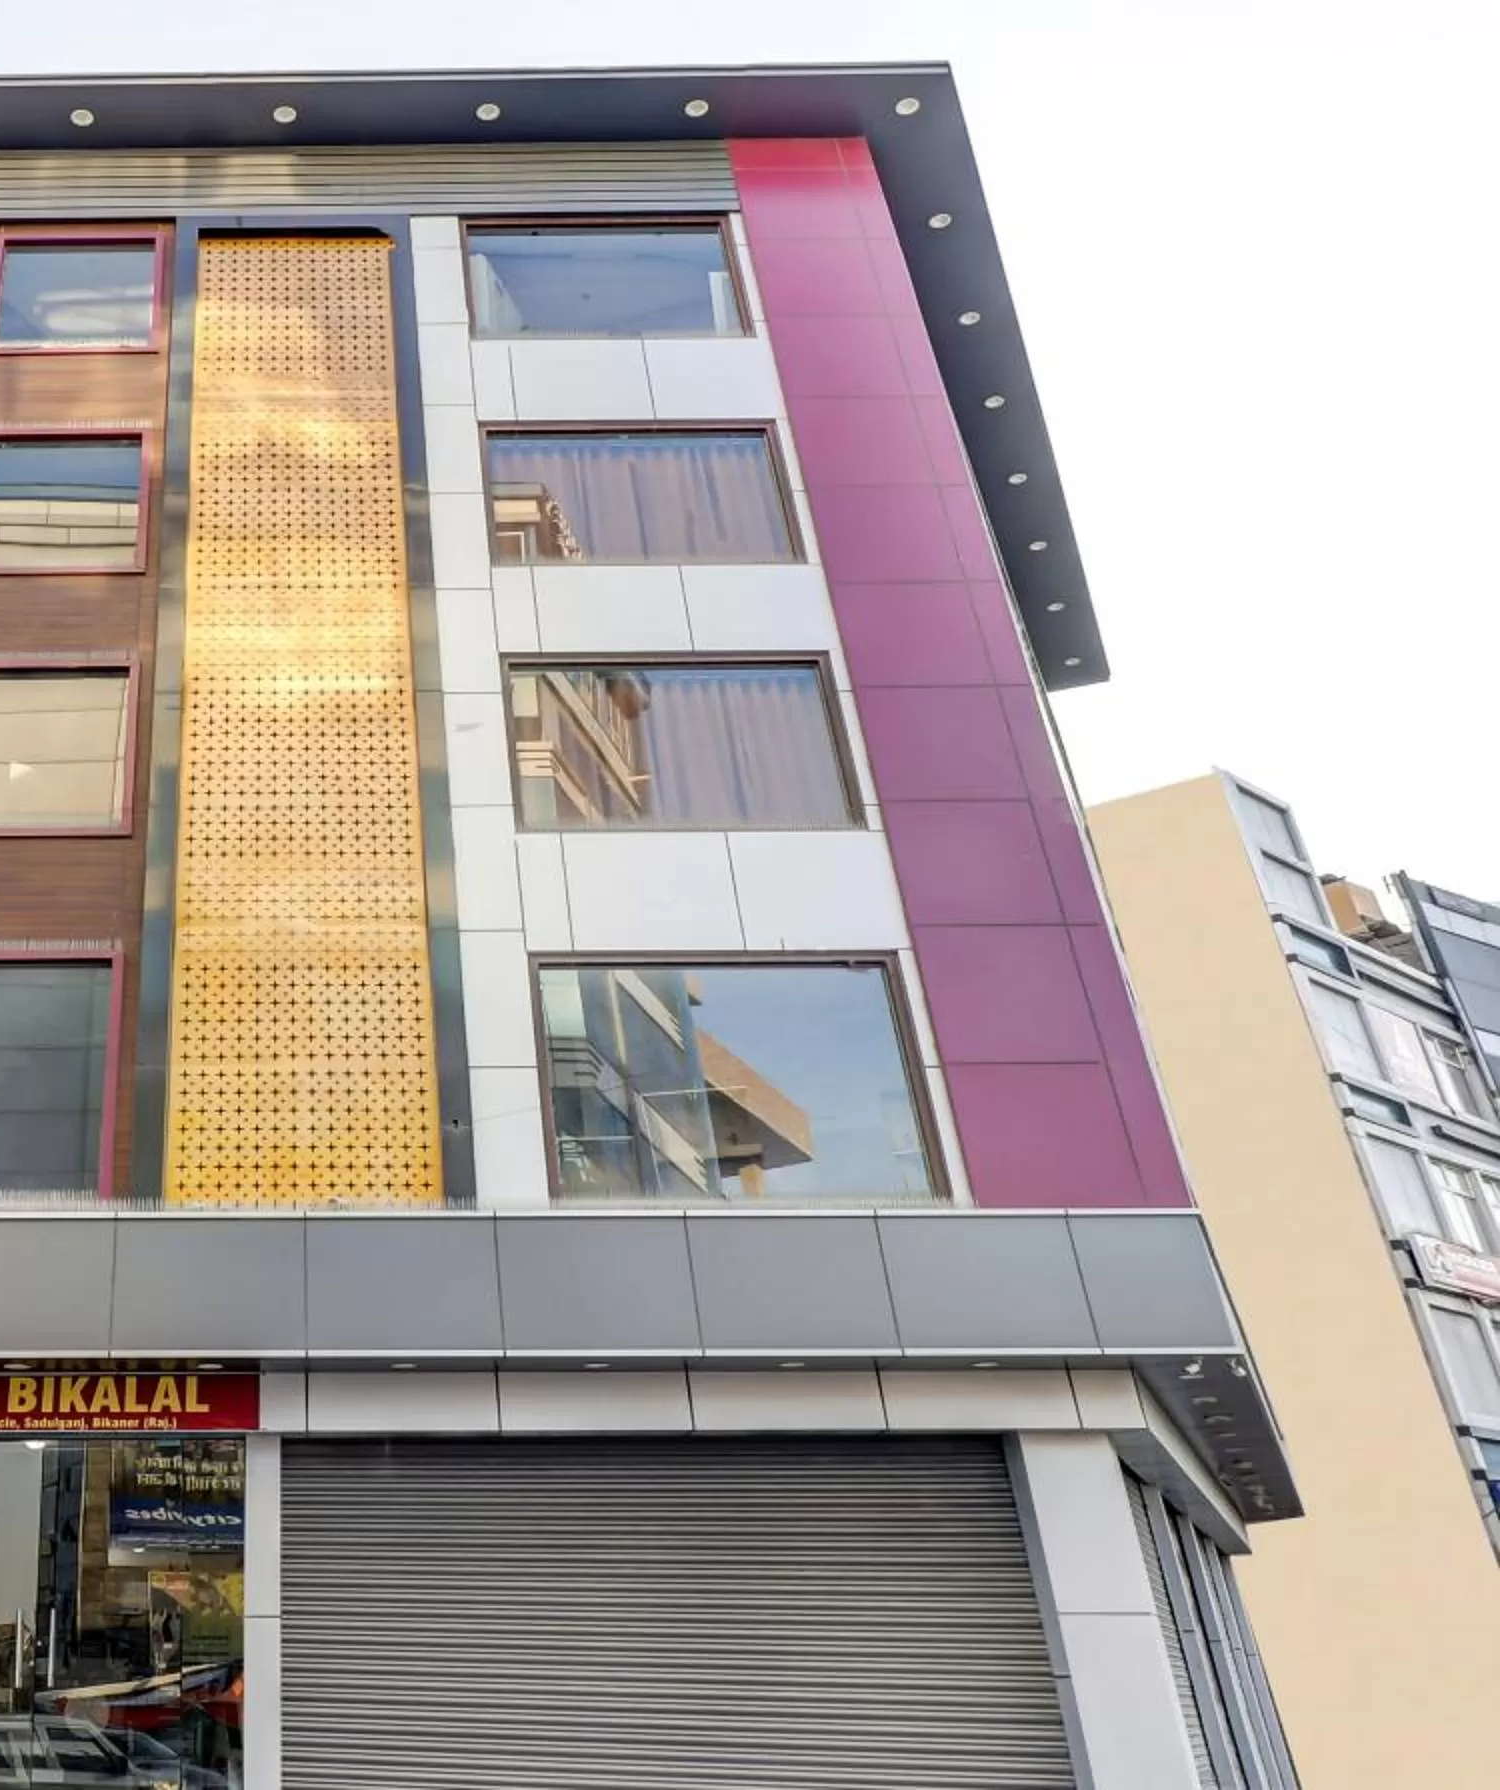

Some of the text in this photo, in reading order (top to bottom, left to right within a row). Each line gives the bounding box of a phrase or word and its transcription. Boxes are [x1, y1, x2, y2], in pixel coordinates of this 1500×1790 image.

[7, 1375, 210, 1413] BIKALAL
[23, 1417, 88, 1430] Sadulganj,
[92, 1417, 139, 1429] Bikaner
[143, 1417, 177, 1430] (Raj.)
